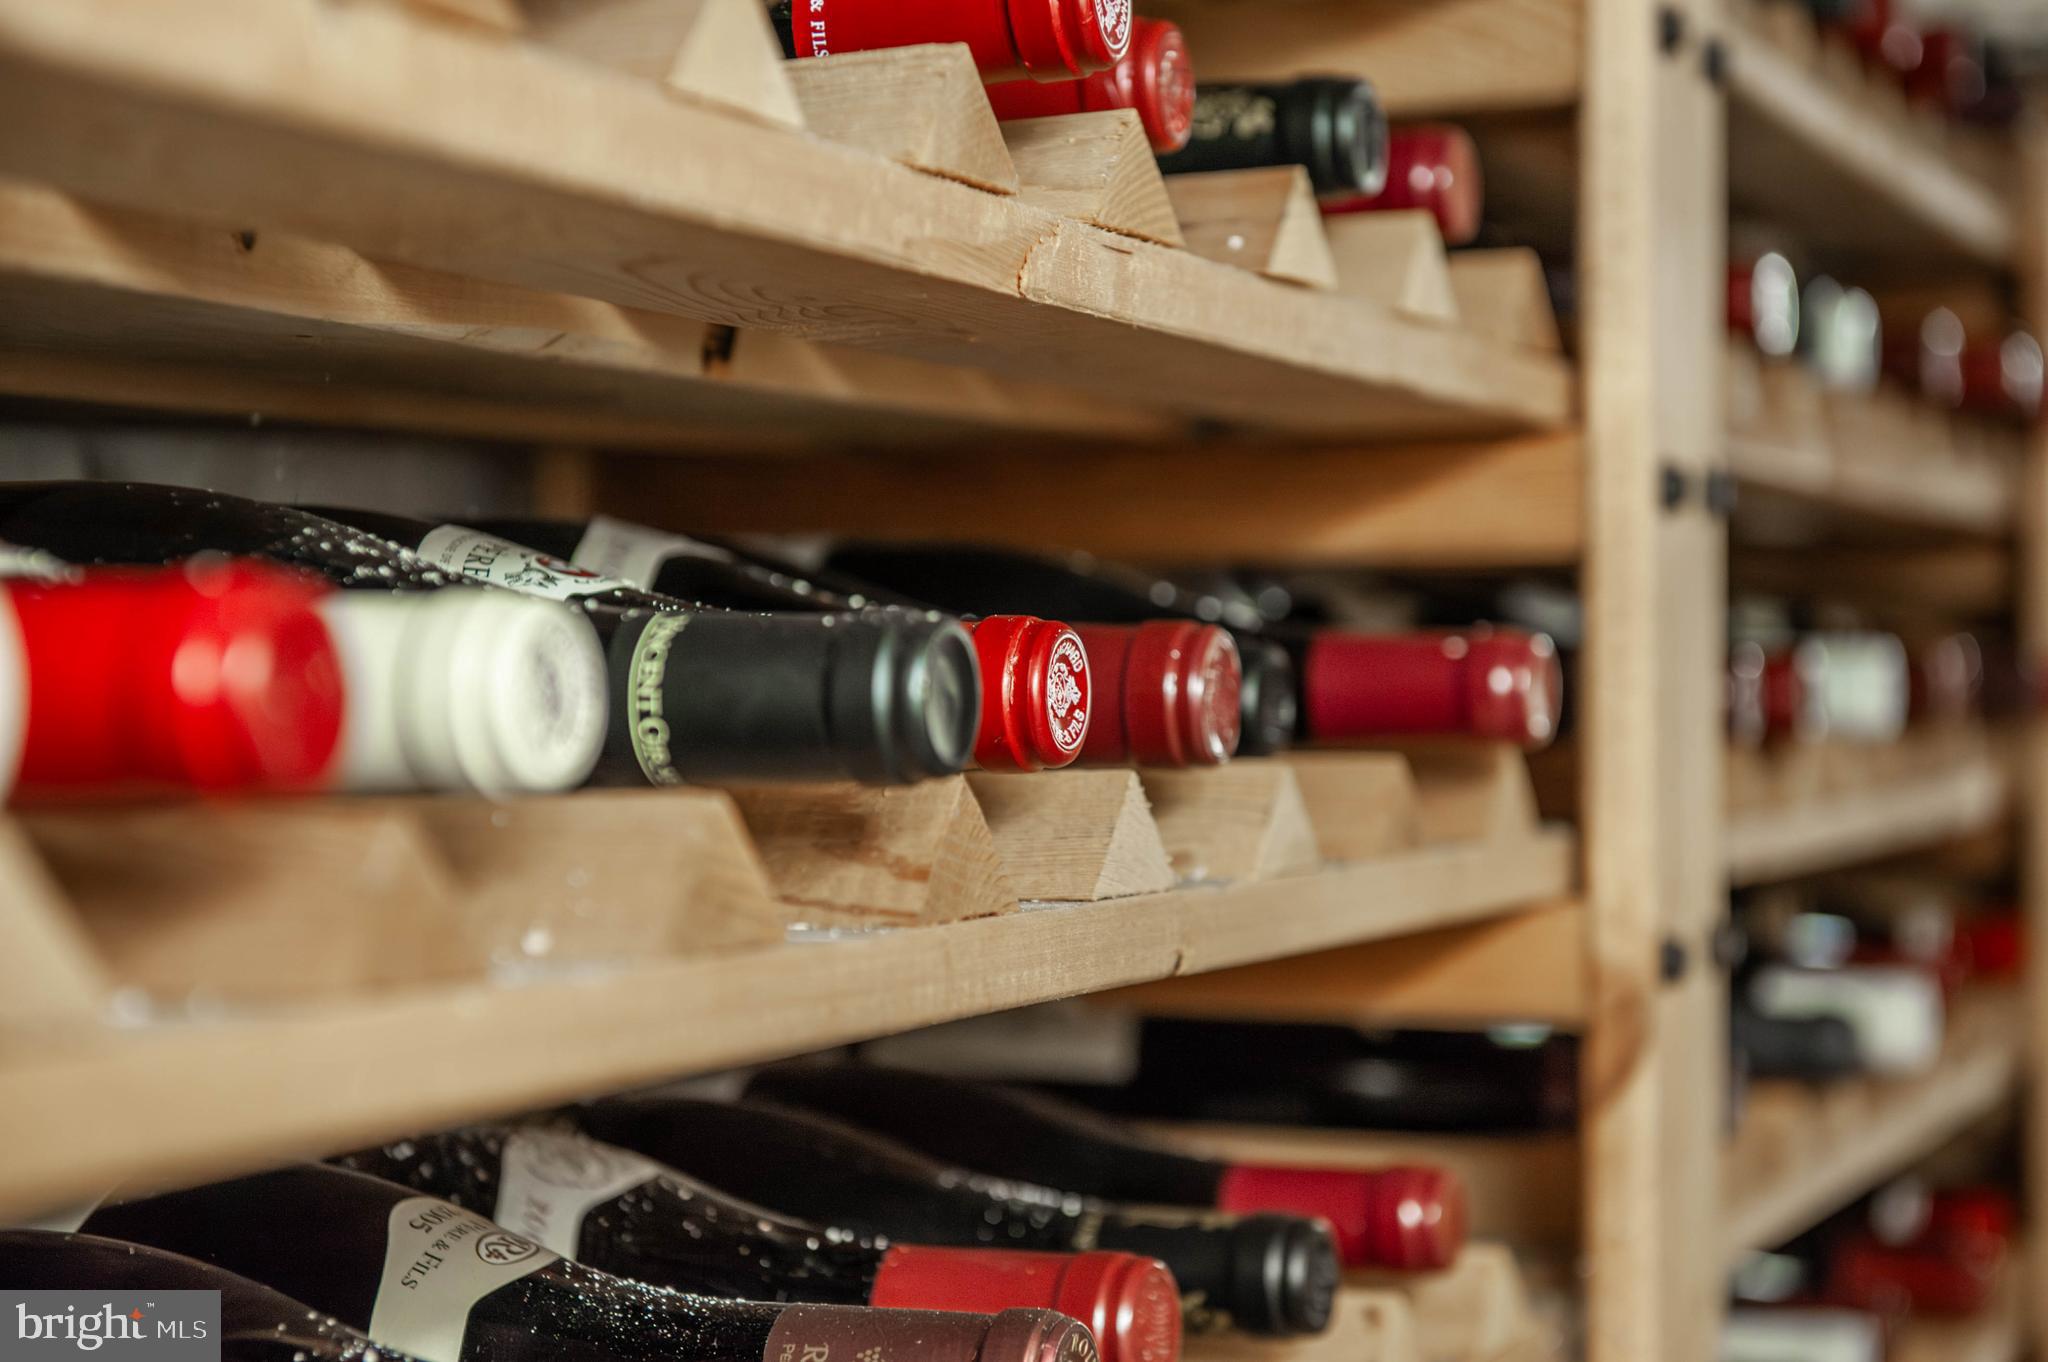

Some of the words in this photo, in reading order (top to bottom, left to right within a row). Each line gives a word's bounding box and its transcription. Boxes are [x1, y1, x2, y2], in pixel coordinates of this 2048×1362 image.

[810, 20, 830, 58] FILS
[1066, 708, 1086, 741] FILS
[400, 1251, 444, 1290] FILS
